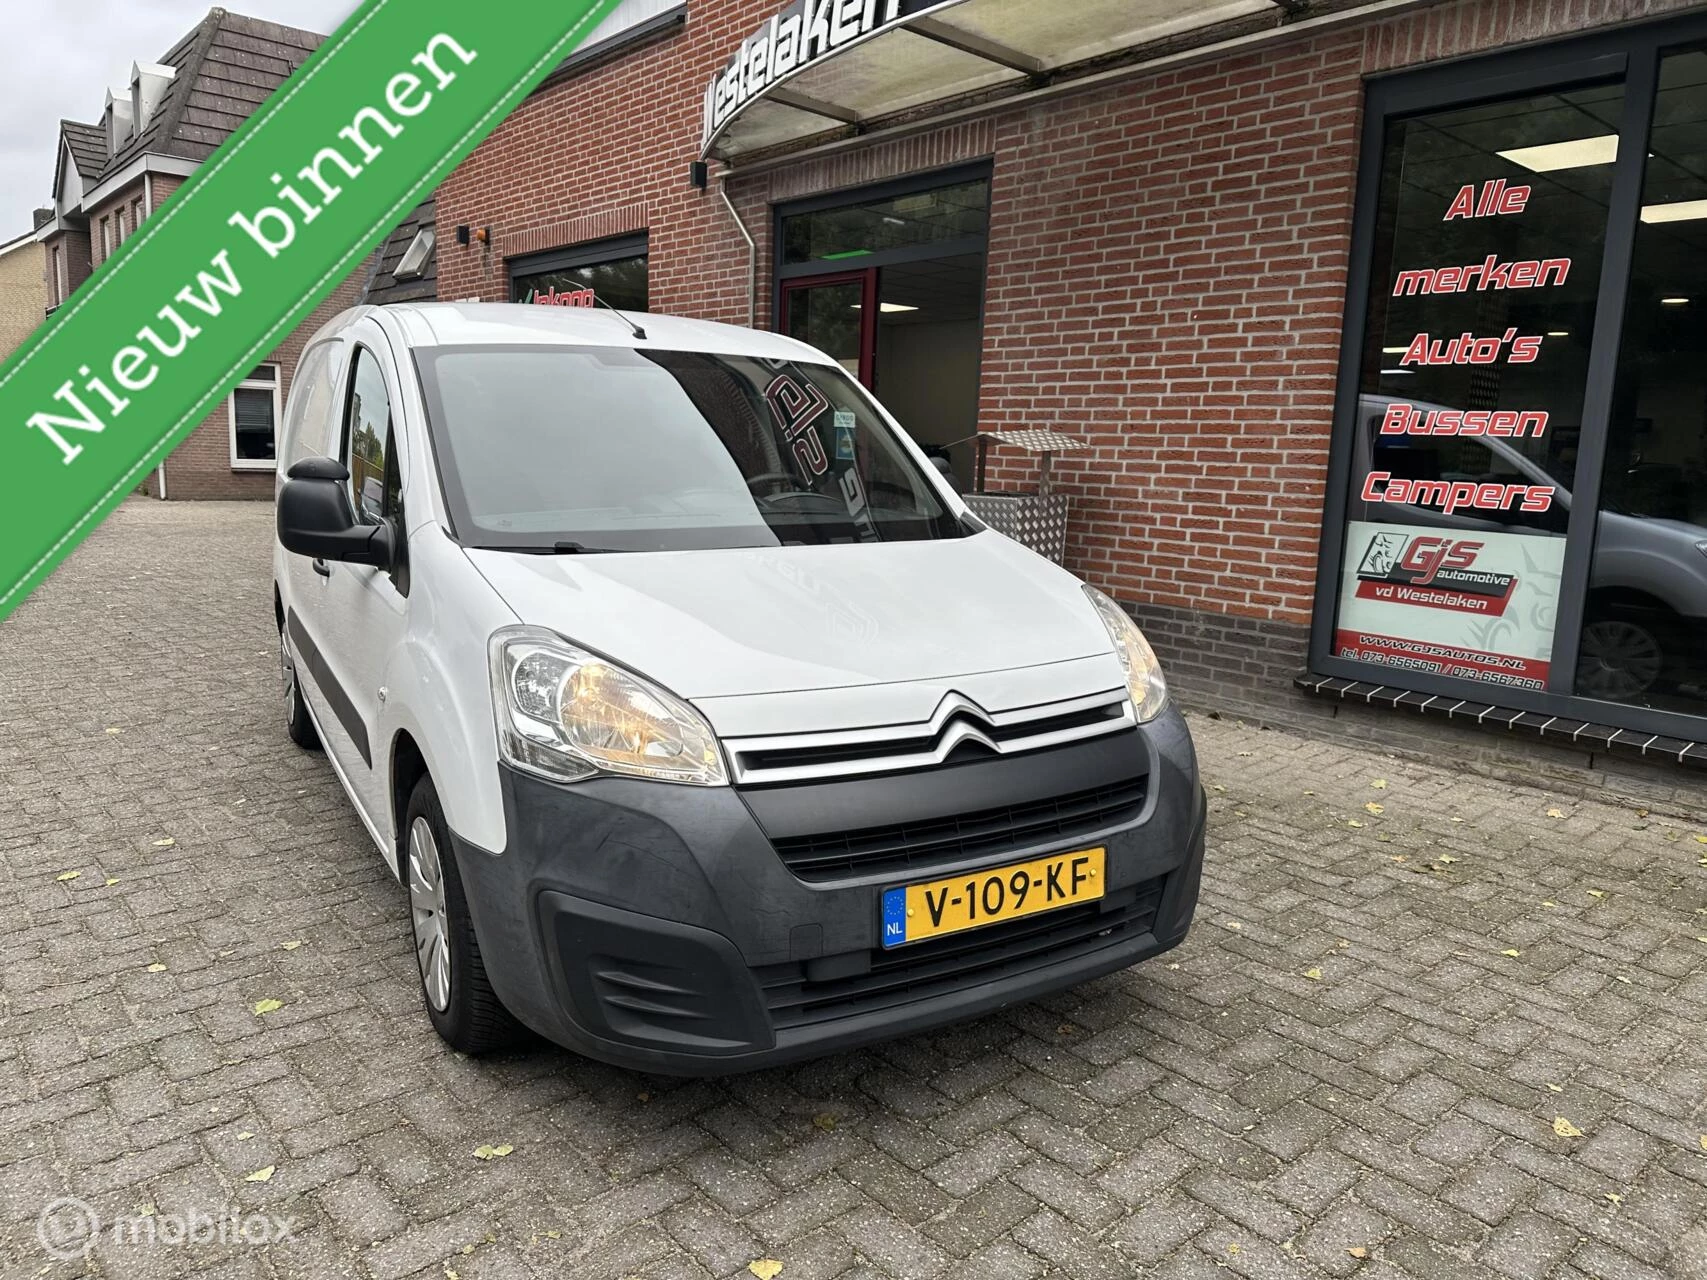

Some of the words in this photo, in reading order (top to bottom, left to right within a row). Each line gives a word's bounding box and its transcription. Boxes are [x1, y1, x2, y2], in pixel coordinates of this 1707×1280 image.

[1443, 178, 1531, 221] Alle
[1392, 254, 1572, 297] merken
[1399, 327, 1543, 366] Auto's
[1380, 403, 1549, 438] Bussen
[1360, 471, 1555, 515] Campers
[1436, 568, 1511, 586] automotive
[1375, 585, 1394, 598] vd
[1397, 588, 1488, 610] Westelaken
[1341, 647, 1359, 660] tel.
[925, 856, 1089, 928] V-109-KF
[887, 923, 903, 936] NL
